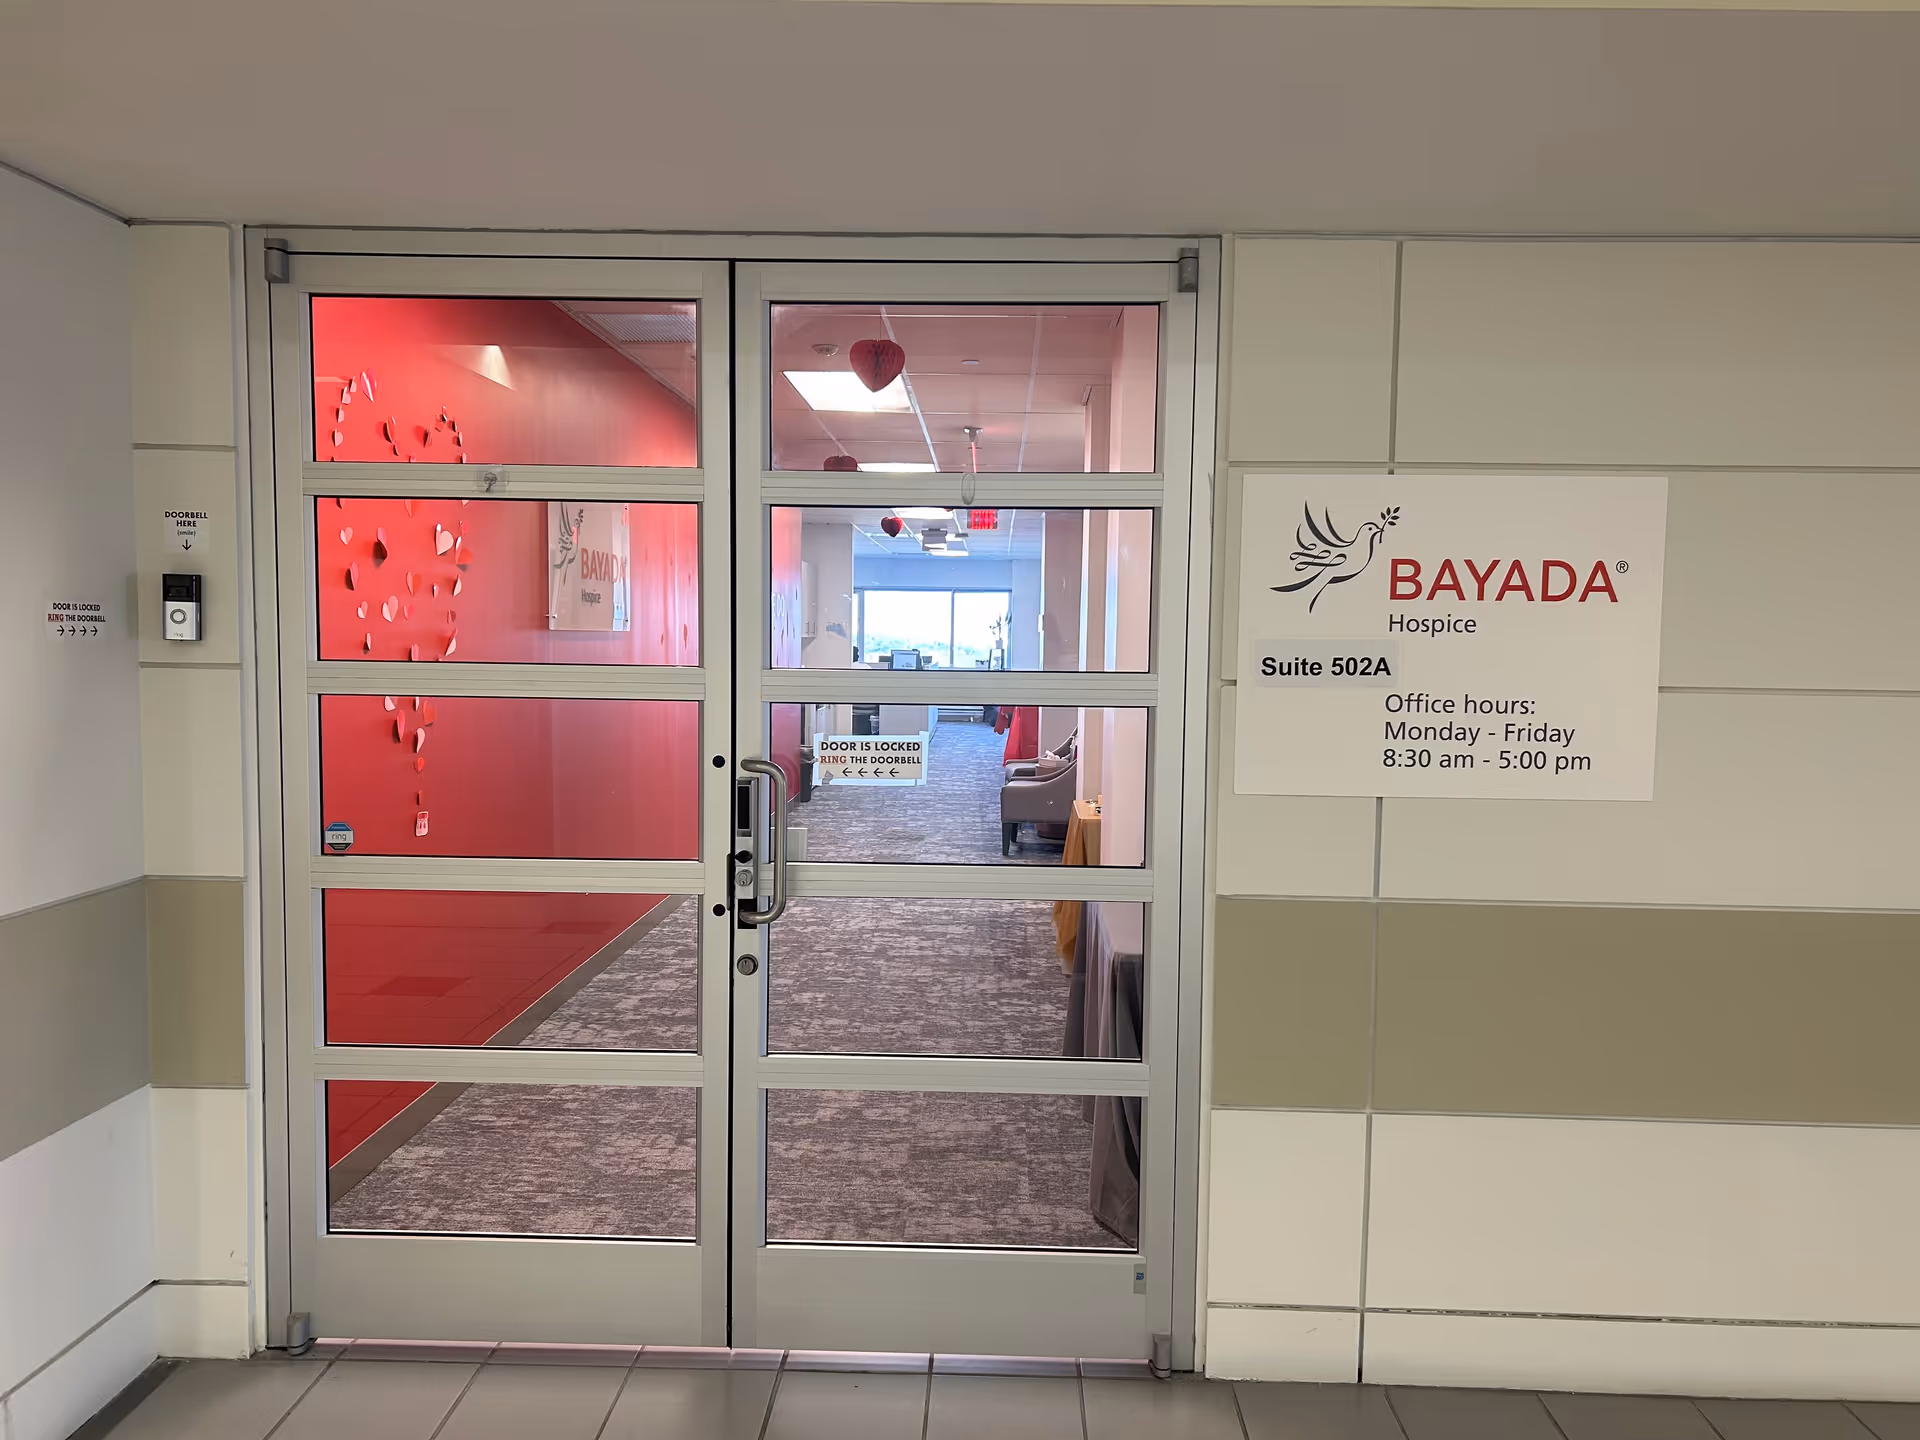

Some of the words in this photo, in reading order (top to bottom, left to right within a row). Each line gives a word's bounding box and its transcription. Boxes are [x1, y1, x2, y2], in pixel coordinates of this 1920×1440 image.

[164, 511, 209, 519] DOORBELL
[176, 519, 197, 528] HERE
[581, 588, 602, 606] Hospice
[52, 602, 71, 611] DOOR
[71, 603, 78, 611] IS
[78, 603, 101, 612] LOCKED
[47, 613, 64, 622] RING
[65, 614, 76, 622] THE
[77, 614, 106, 623] DOORBELL
[1388, 613, 1478, 638] Hospice
[1260, 656, 1323, 677] Suite
[1330, 656, 1392, 677] 502A
[1384, 692, 1456, 715] Office
[1463, 693, 1536, 716] hours:
[1383, 720, 1481, 747] Monday
[1503, 722, 1576, 749] Friday
[820, 741, 857, 752] DOOR
[860, 741, 872, 752] IS
[874, 741, 921, 752] LOCKED
[820, 755, 847, 764] RING
[850, 756, 868, 764] THE
[870, 756, 922, 765] DOORBELL
[1382, 748, 1432, 769] 8:30
[1438, 752, 1475, 769] am
[1498, 750, 1547, 771] 5:00
[1554, 753, 1592, 775] pm
[331, 832, 347, 842] ring
